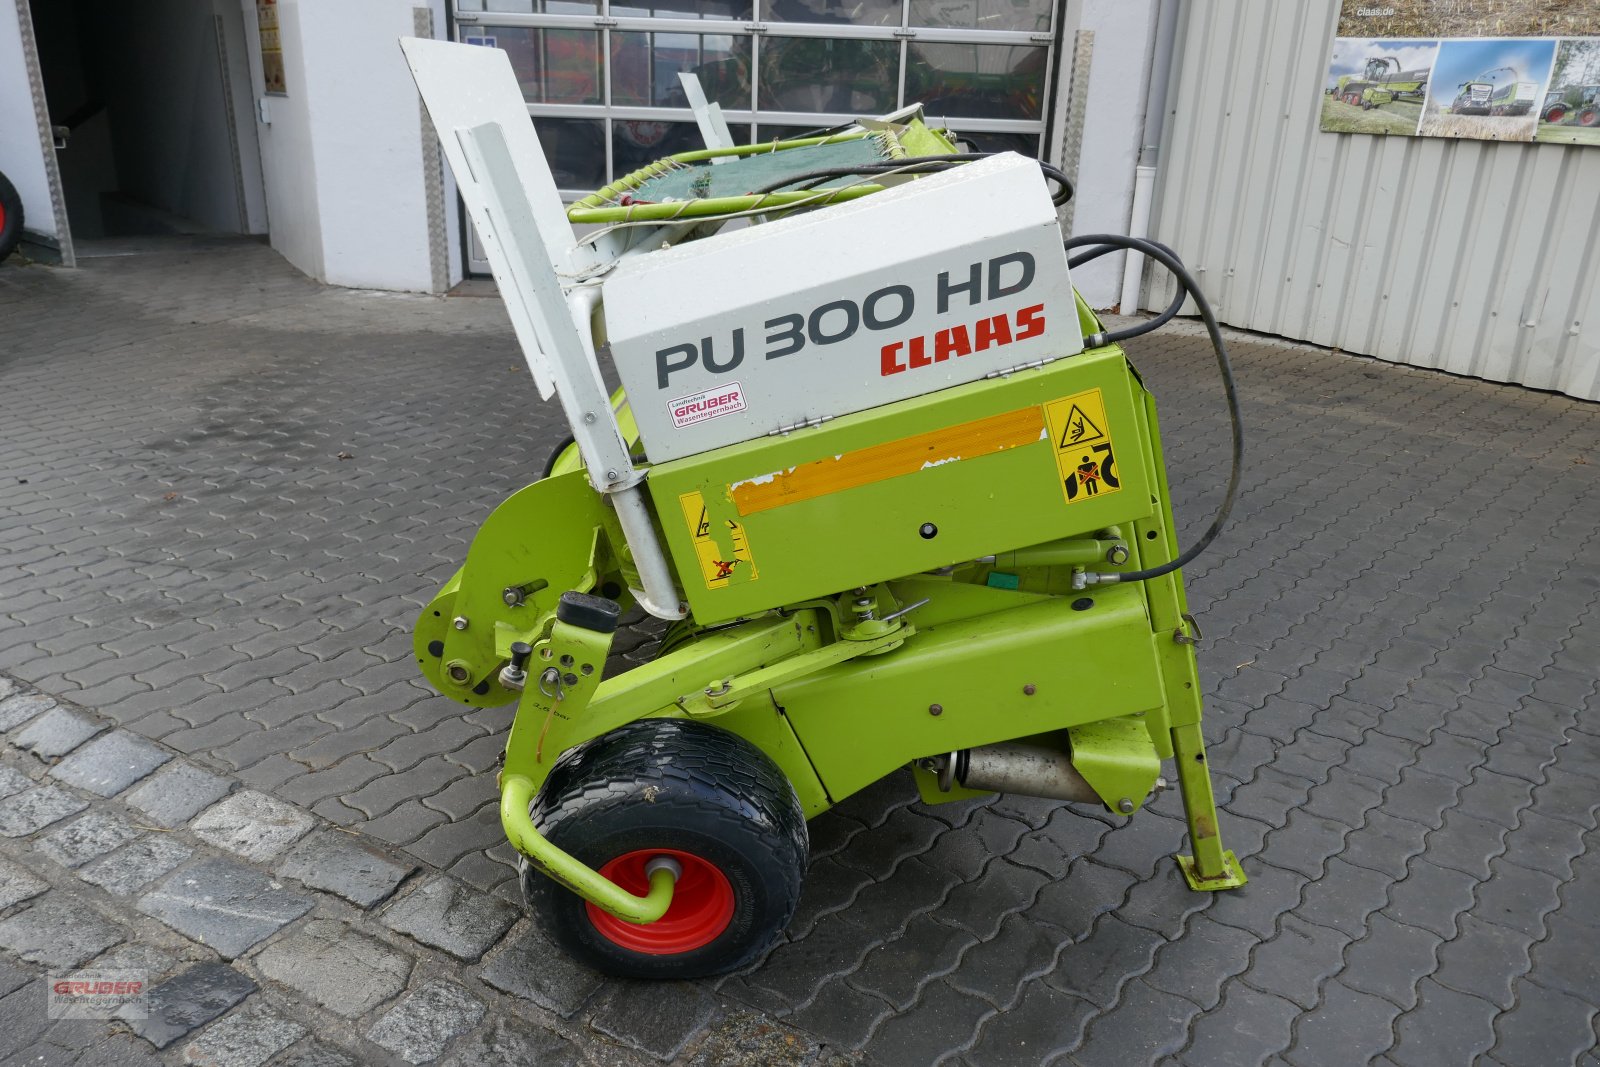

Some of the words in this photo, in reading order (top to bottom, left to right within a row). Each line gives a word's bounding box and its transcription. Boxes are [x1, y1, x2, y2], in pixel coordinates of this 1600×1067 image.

[1356, 7, 1395, 17] claas.de
[655, 327, 745, 390] PU
[764, 284, 915, 361] 300
[936, 251, 1036, 315] HD
[880, 303, 1046, 377] CLAAS
[671, 394, 706, 408] Landtechnik
[674, 391, 739, 418] GRUBER
[676, 401, 742, 425] Wasentegernbach
